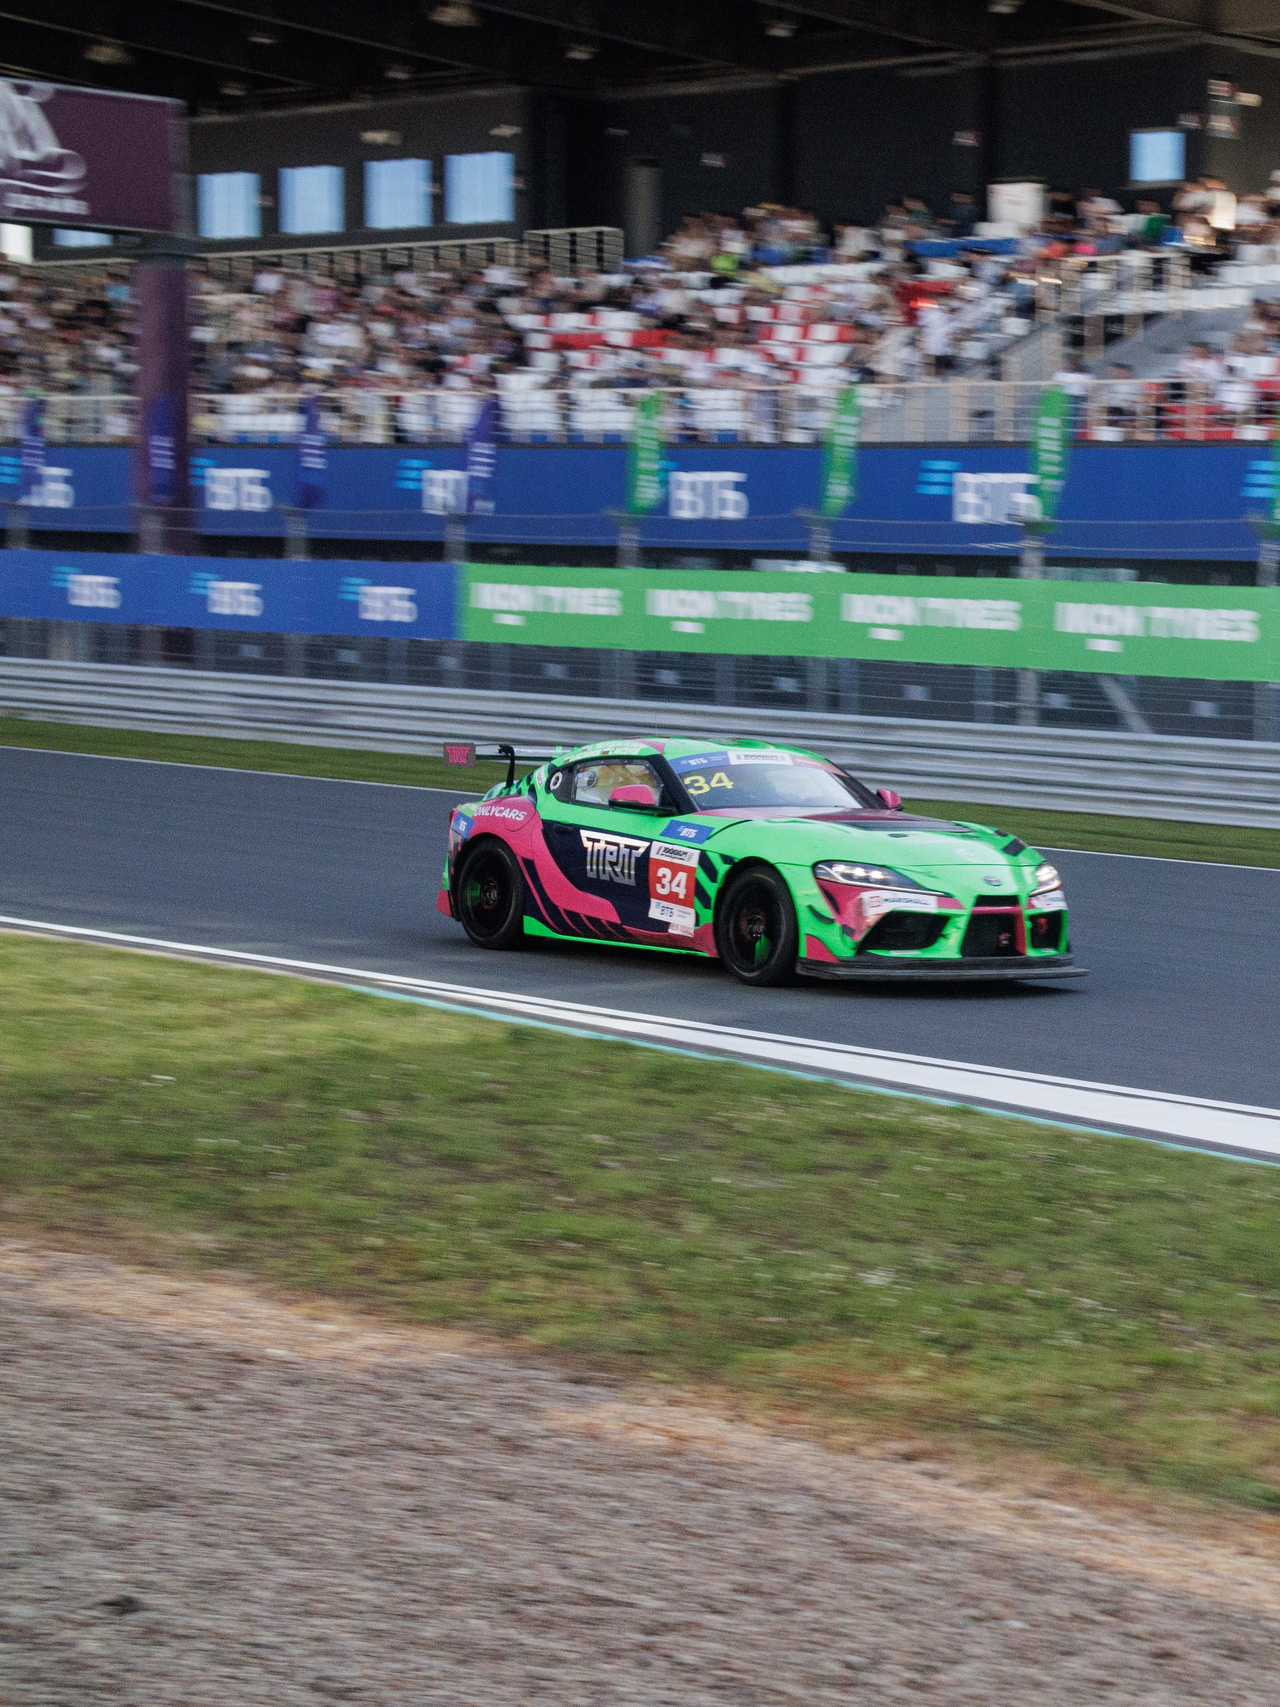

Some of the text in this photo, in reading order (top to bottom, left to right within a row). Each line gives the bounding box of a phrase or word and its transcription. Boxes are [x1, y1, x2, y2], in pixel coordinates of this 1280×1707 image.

[683, 771, 735, 796] 34
[473, 805, 527, 821] ONLYCARS
[680, 828, 698, 839] ВТБ
[655, 867, 688, 899] 34
